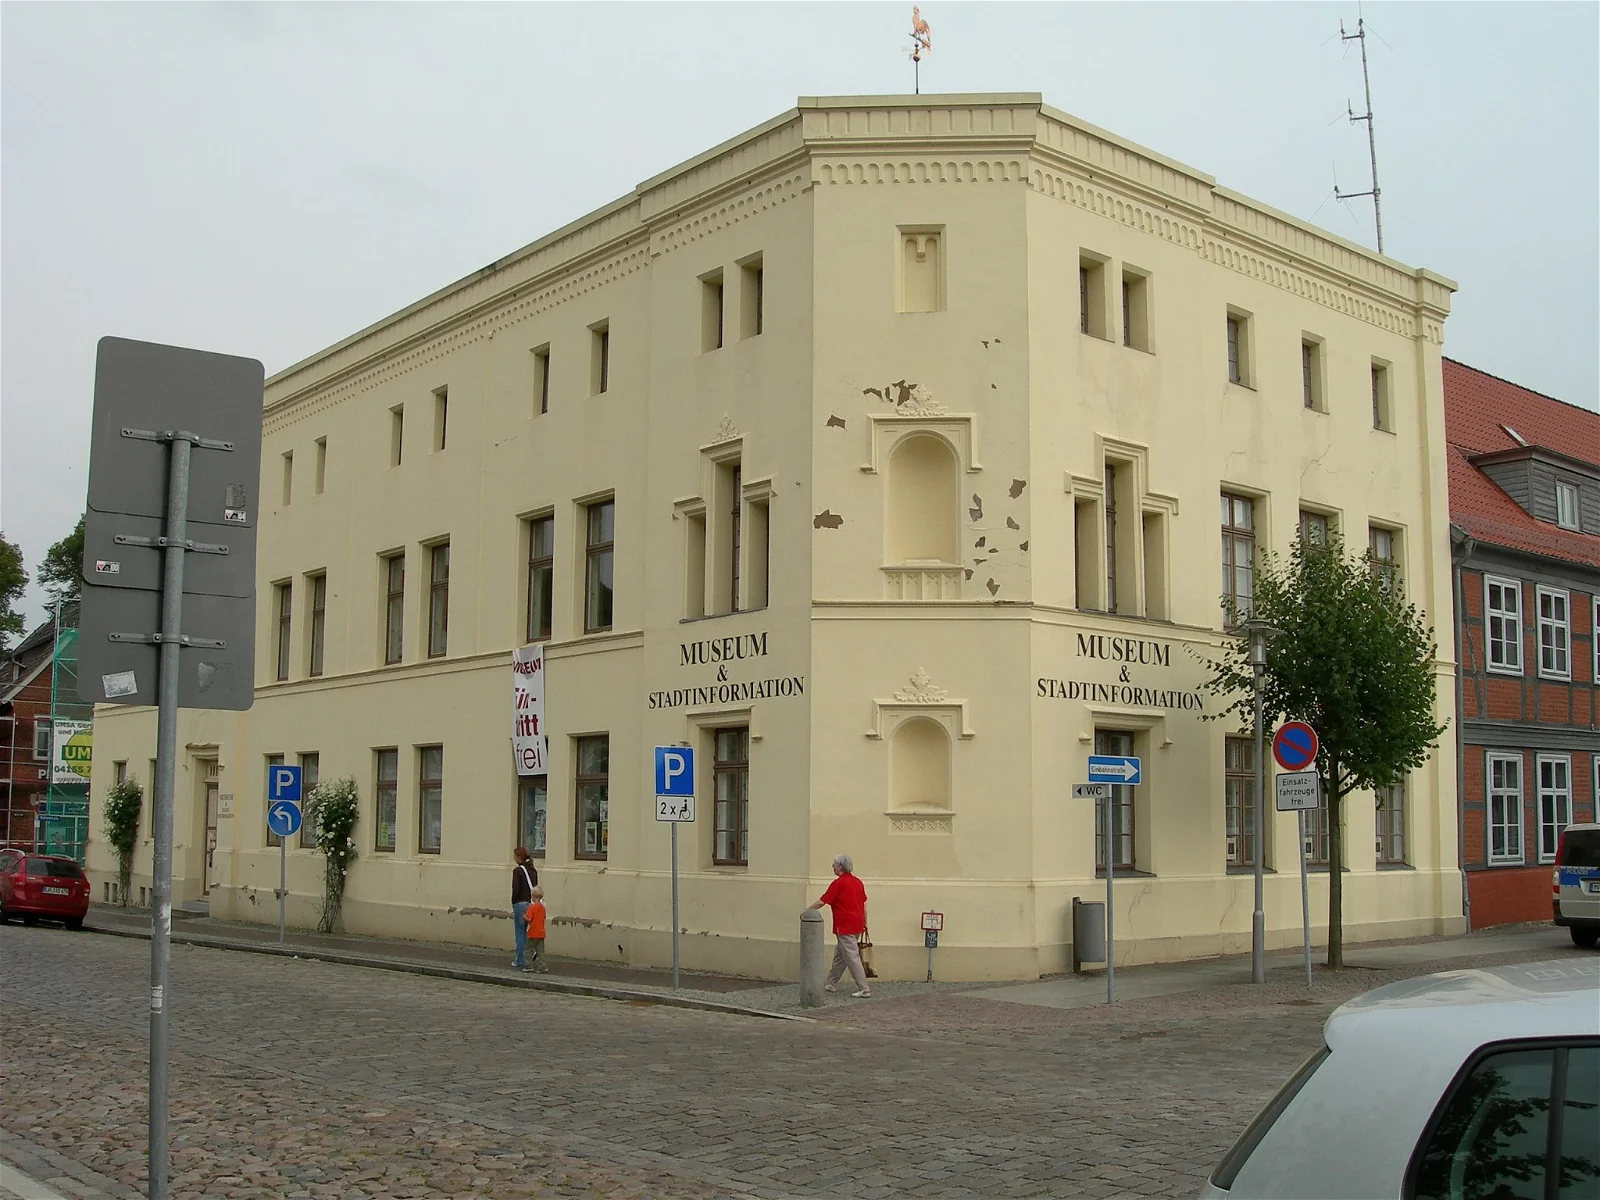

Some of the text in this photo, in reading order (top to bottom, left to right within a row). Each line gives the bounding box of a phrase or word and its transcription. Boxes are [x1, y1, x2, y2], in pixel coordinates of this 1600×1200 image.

[680, 631, 768, 666] MUSEUM
[1076, 633, 1171, 667] MUSEUM
[717, 664, 728, 682] &
[1118, 664, 1131, 683] &
[648, 677, 805, 709] STADTINFORMATION
[1037, 678, 1204, 711] STADTINFORMATION
[664, 753, 686, 790] P
[1091, 766, 1126, 774] Einbahnstraße
[276, 769, 294, 796] P
[1086, 786, 1103, 796] WC
[1282, 778, 1311, 787] Einsatz-
[1279, 788, 1315, 797] fahrzeuge
[660, 801, 667, 815] 2
[1291, 798, 1304, 806] frei
